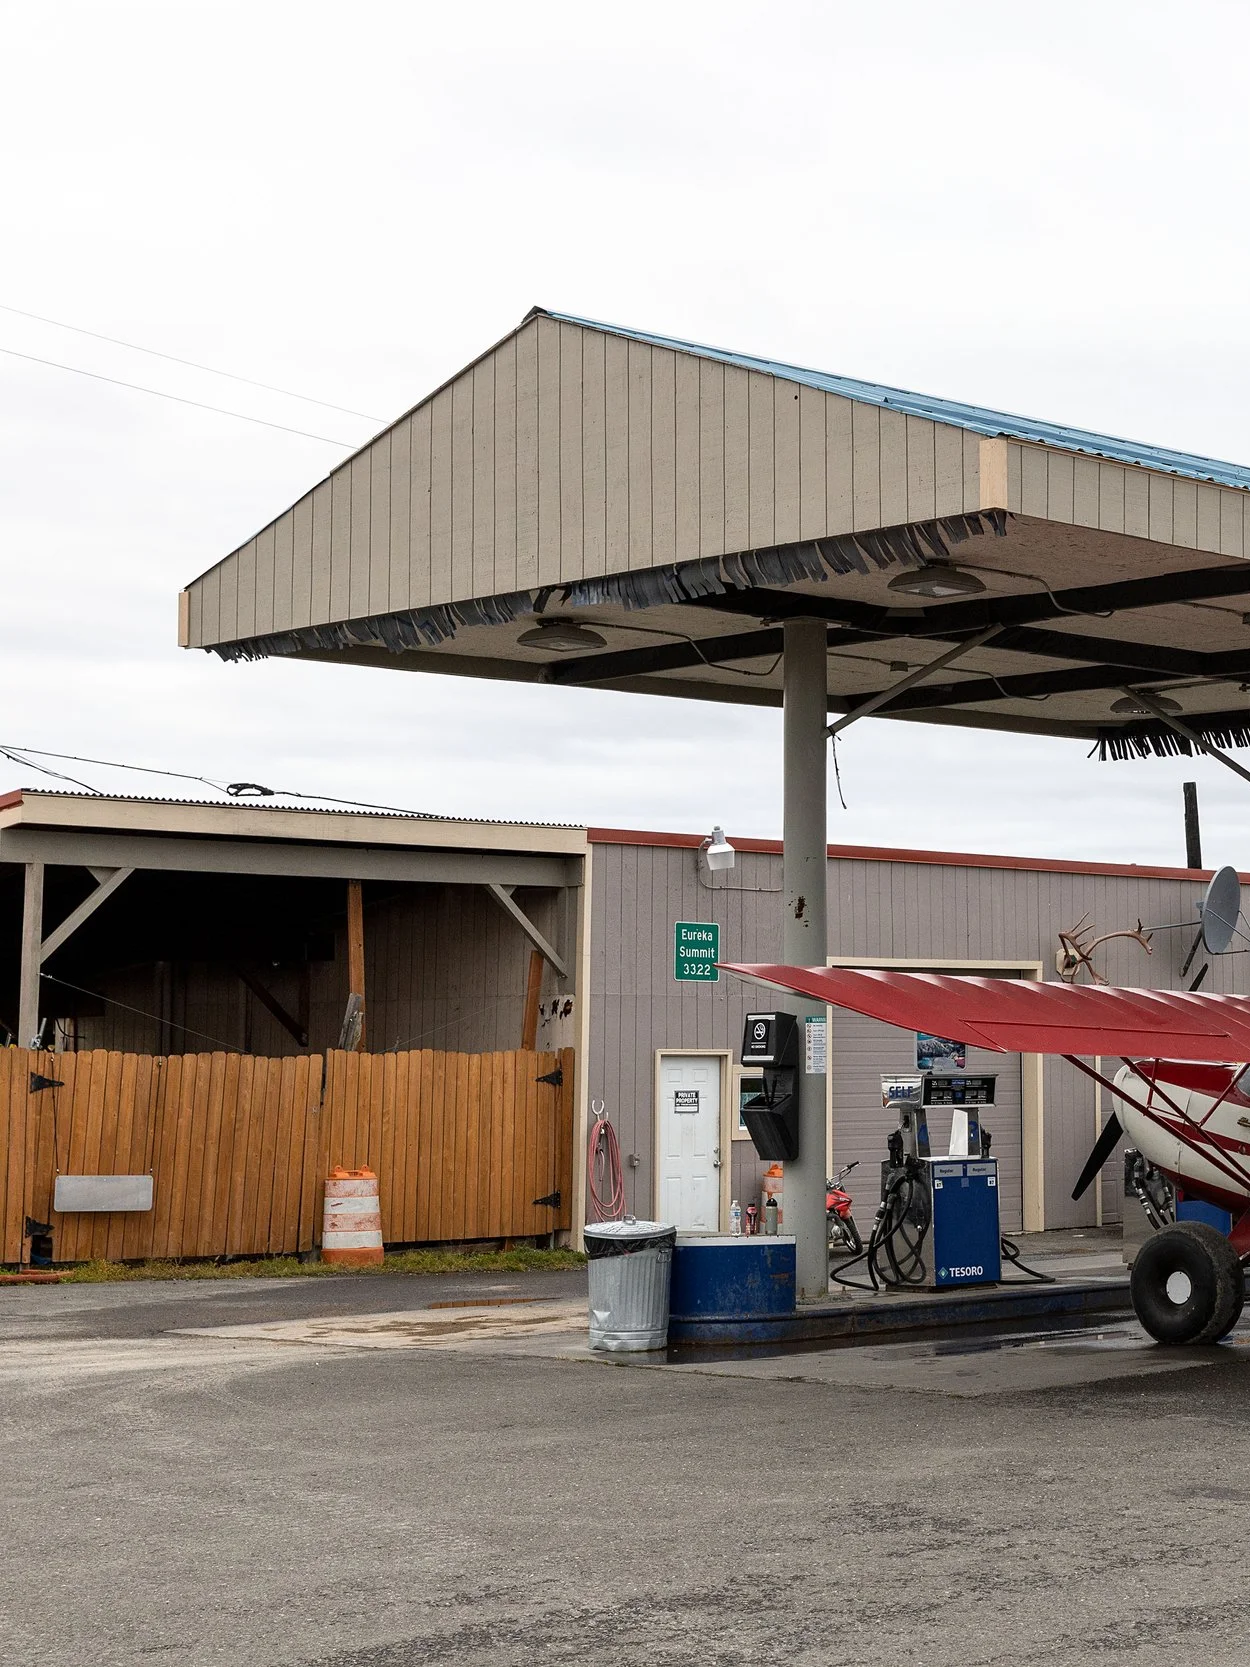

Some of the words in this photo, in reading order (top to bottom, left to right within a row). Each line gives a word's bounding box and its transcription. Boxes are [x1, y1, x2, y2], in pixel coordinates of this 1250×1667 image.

[681, 929, 713, 941] Eureka
[679, 946, 715, 959] Summit
[683, 963, 711, 975] 3322
[888, 1086, 914, 1099] SELF
[949, 1265, 984, 1278] TESORO
